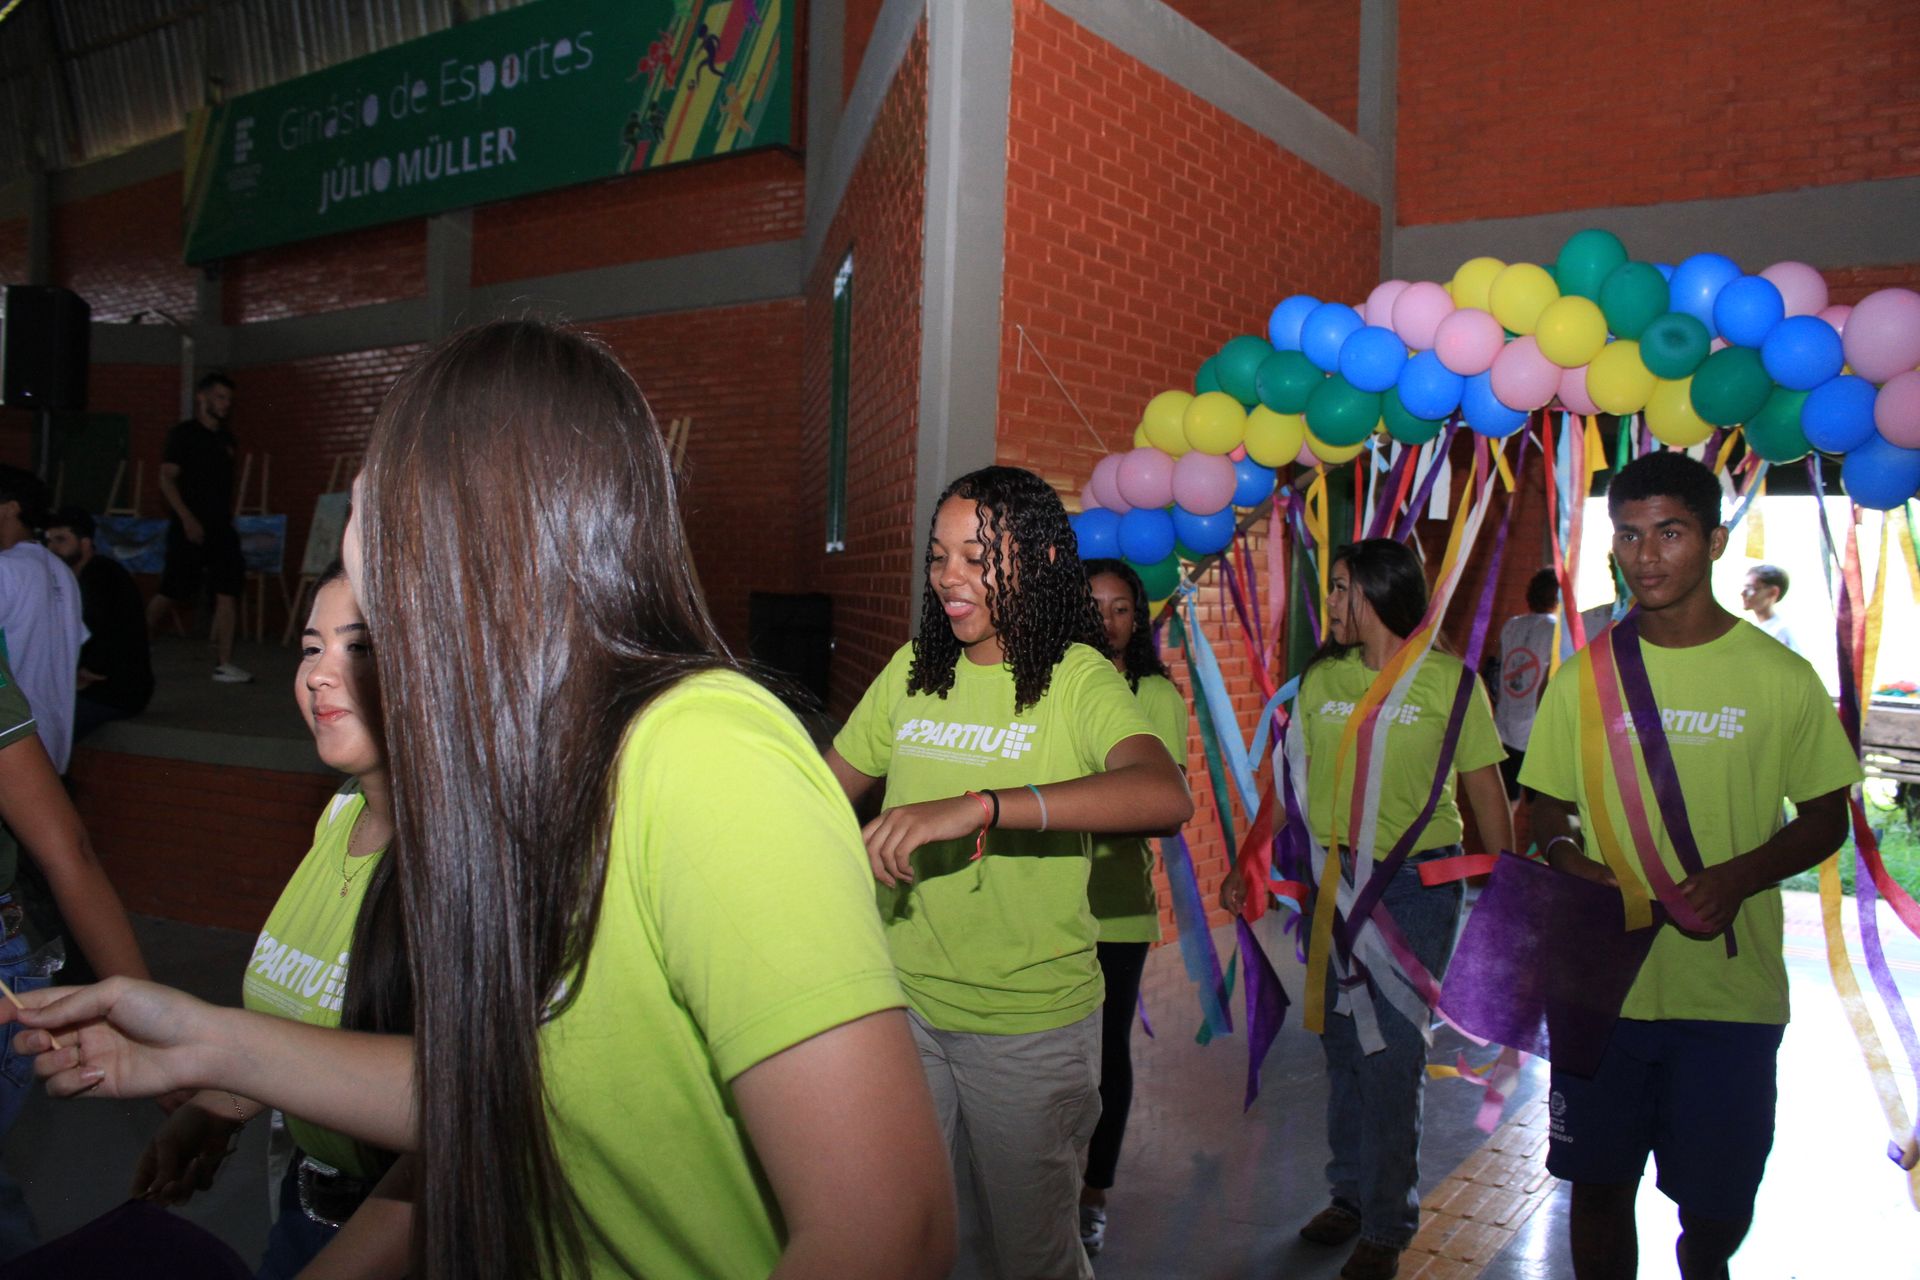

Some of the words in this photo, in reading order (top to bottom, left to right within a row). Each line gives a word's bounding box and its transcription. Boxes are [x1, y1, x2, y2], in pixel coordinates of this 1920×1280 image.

[277, 87, 379, 150] Ginásio
[390, 71, 428, 119] de
[439, 30, 594, 109] Esportes
[317, 157, 392, 215] JÚLIO
[397, 126, 517, 188] MÜLLER
